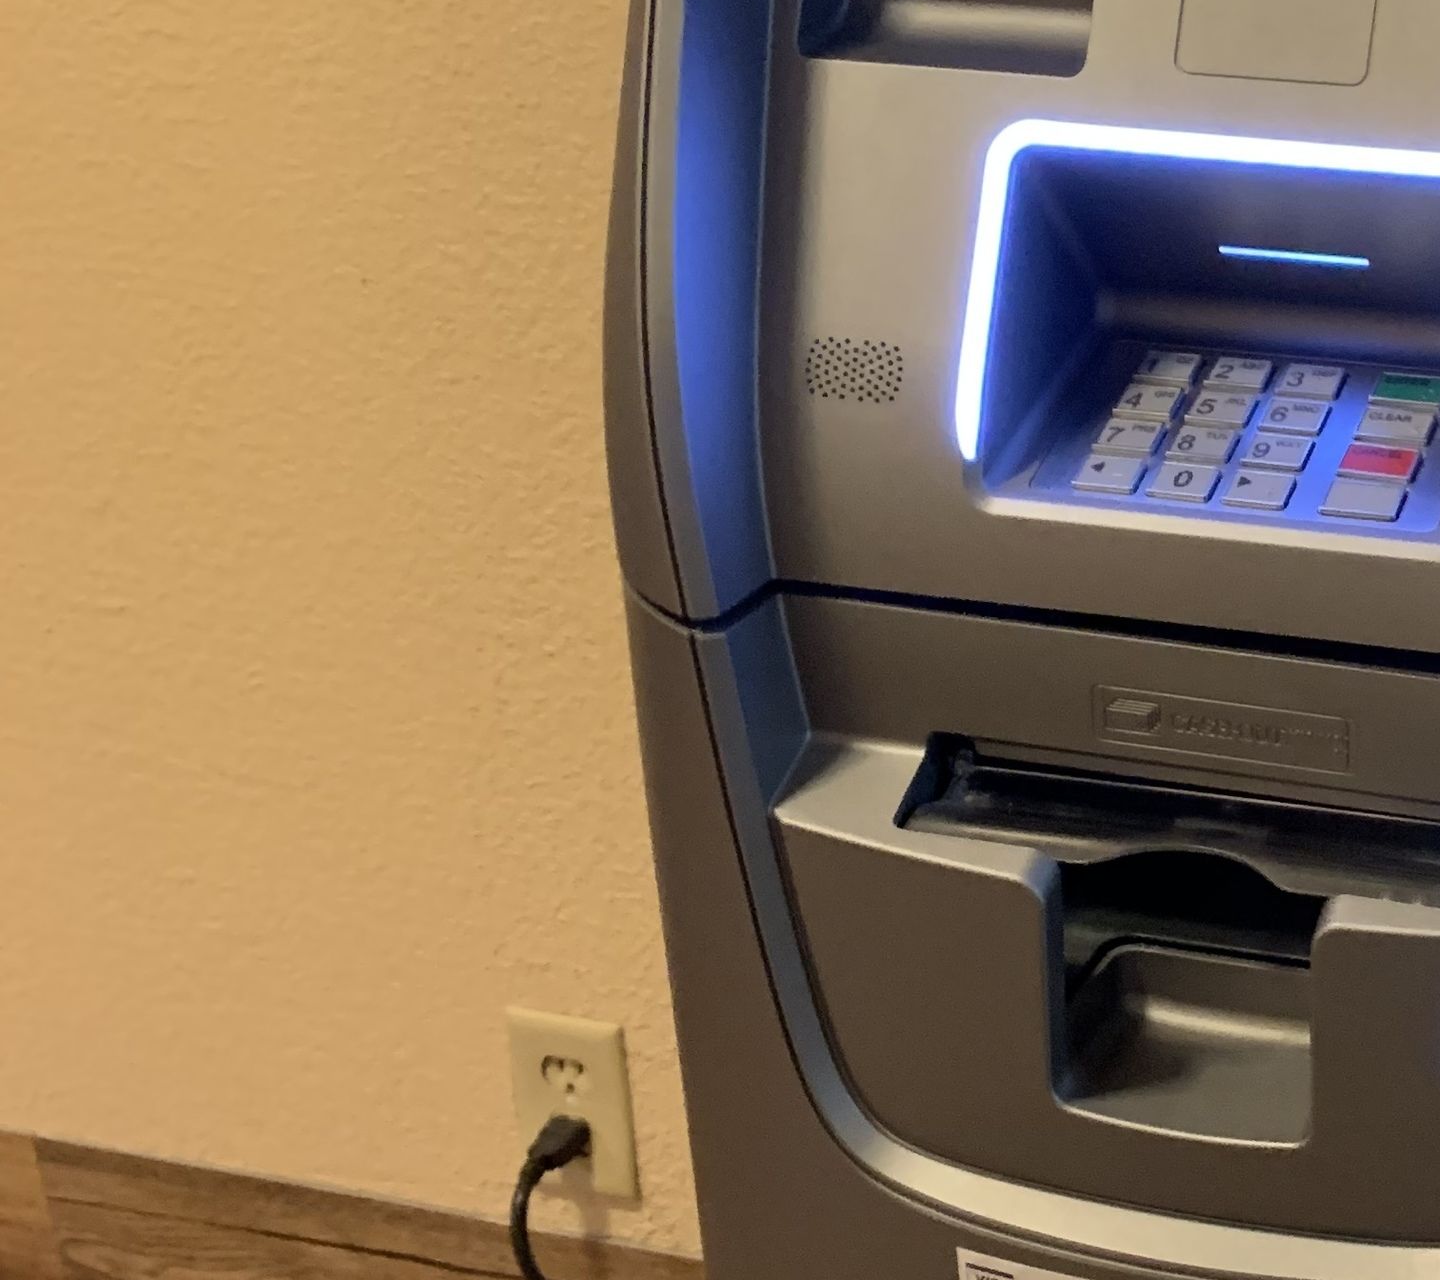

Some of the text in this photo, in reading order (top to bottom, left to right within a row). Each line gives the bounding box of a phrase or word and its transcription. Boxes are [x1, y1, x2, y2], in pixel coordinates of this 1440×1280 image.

[1214, 364, 1235, 380] 2
[1286, 371, 1305, 388] 3
[1125, 392, 1144, 408] 4
[1196, 398, 1218, 415] 5
[1270, 405, 1289, 422] 6
[1107, 425, 1127, 443] 7
[1177, 433, 1197, 451] 8
[1251, 441, 1272, 458] 9
[1173, 469, 1194, 488] 0
